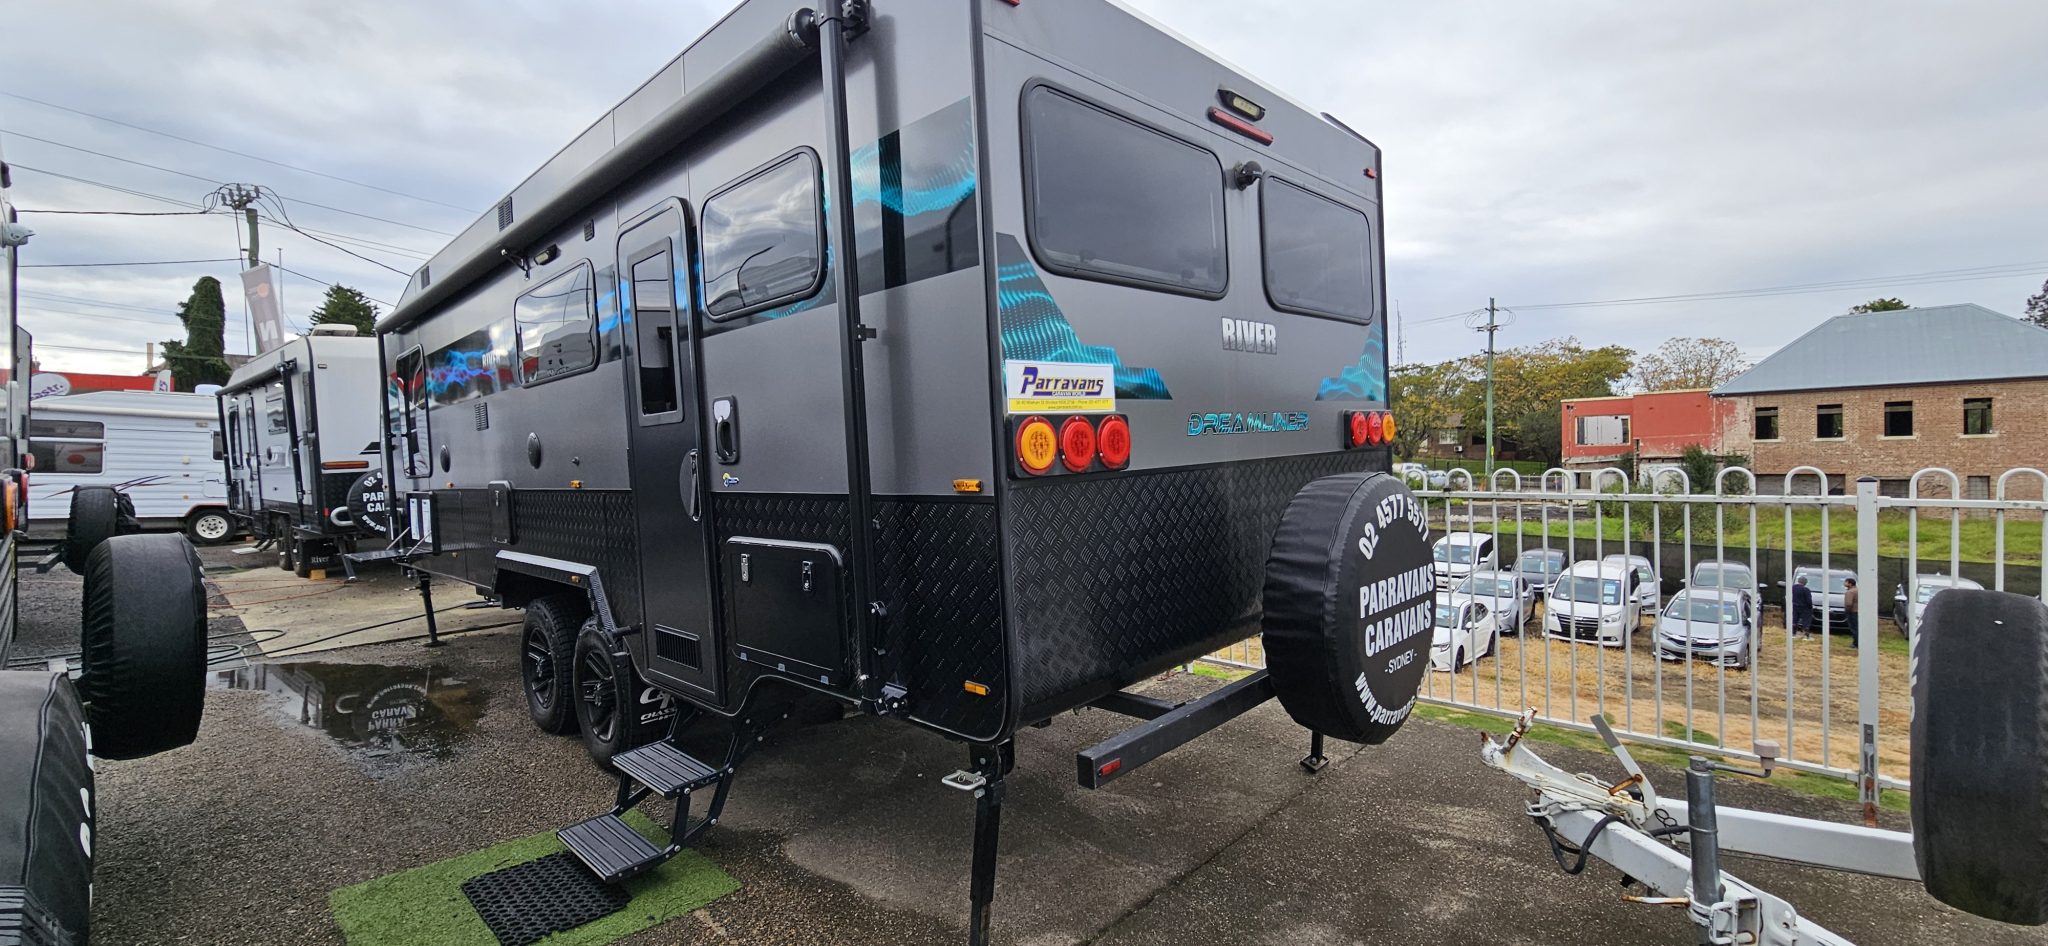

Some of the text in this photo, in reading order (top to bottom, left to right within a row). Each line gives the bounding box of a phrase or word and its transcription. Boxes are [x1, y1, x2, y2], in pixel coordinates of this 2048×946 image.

[1221, 316, 1278, 355] RIVER
[1020, 366, 1104, 395] Parravans
[1187, 411, 1309, 436] DREAMLINER
[362, 491, 385, 502] PAR
[1358, 493, 1429, 560] 02 4577 5577
[1359, 562, 1434, 619] PARRAVANS
[1365, 599, 1432, 658] CARAVANS
